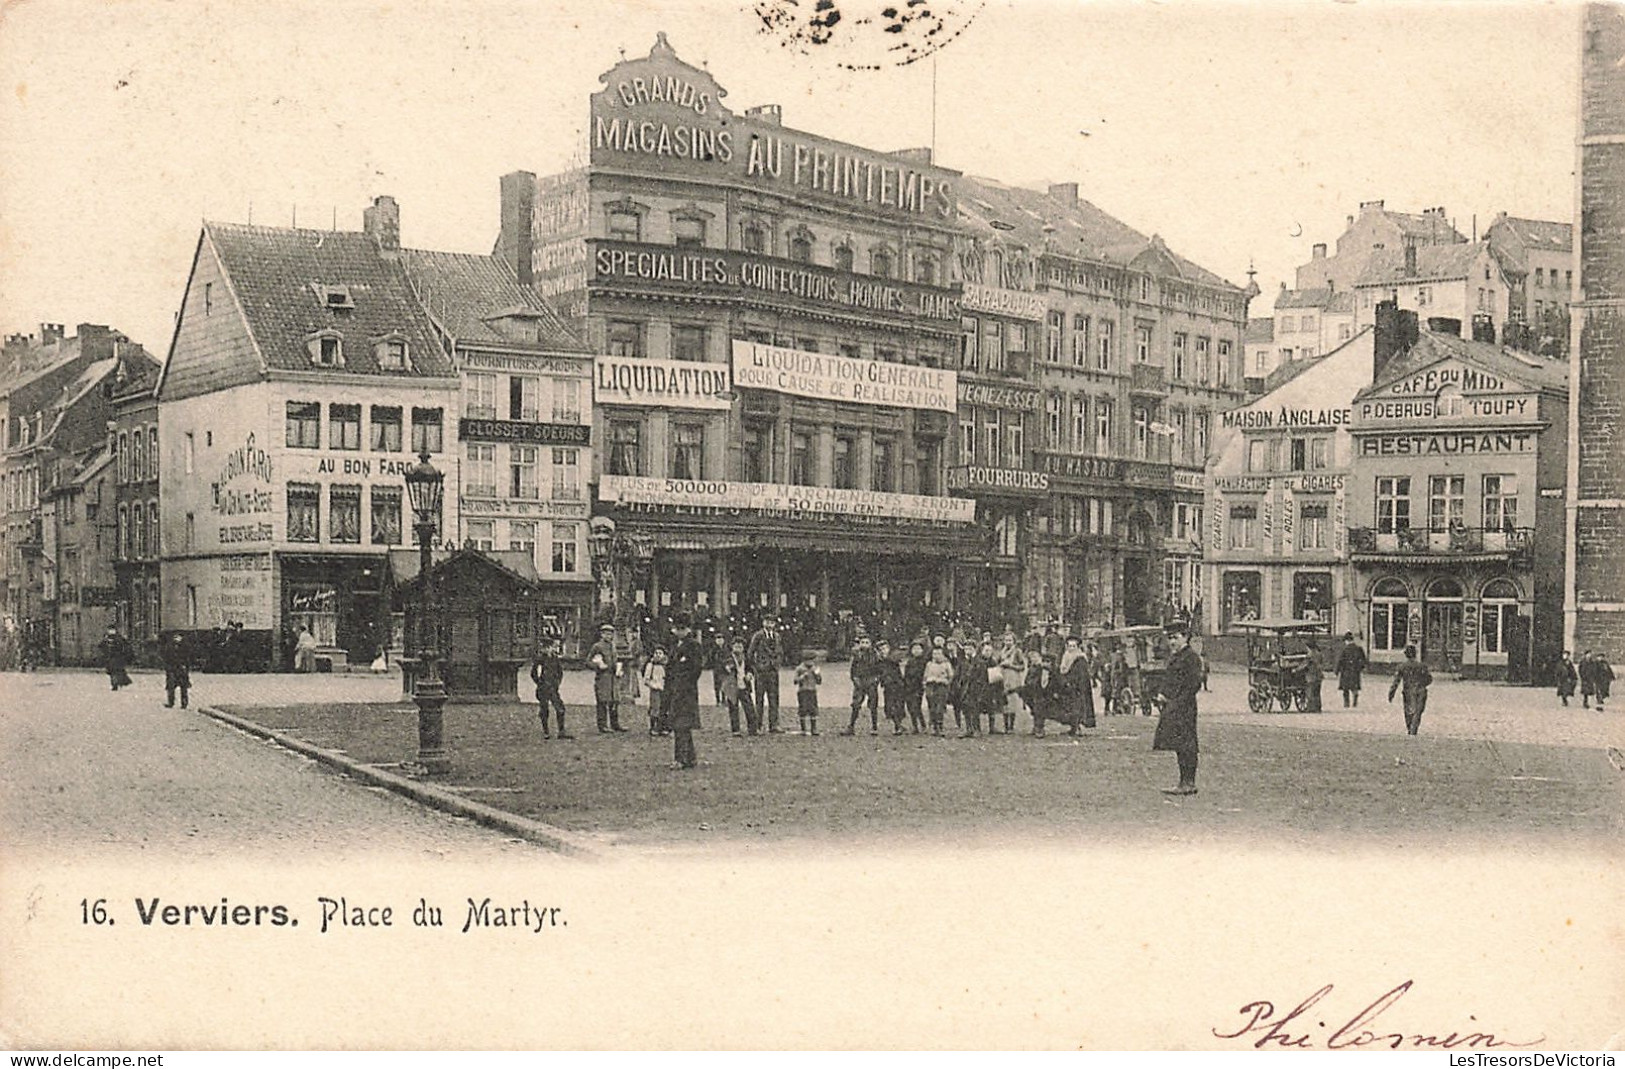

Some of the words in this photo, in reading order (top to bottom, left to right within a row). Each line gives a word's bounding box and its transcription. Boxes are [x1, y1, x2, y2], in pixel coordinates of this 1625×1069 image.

[618, 75, 711, 115] GRANDS
[596, 115, 733, 163] MAGASINS
[748, 133, 782, 178] AU
[597, 249, 728, 284] SPECIALITES
[742, 261, 838, 302] CONFECTIONS
[850, 280, 904, 311] HOMMES
[919, 293, 962, 320] DAMES
[467, 352, 538, 370] FOURNITURES
[753, 345, 863, 381] LIQUIDATION
[598, 363, 726, 400] LIQUIDATION
[739, 368, 773, 386] POUR
[778, 372, 823, 392] CAUSE
[830, 381, 846, 397] DE
[853, 383, 948, 408] REALISATION
[1440, 369, 1459, 383] DU
[1462, 369, 1504, 391] MIDI
[1222, 410, 1273, 428] MAISON
[1278, 406, 1352, 426] ANGLAISE
[1469, 399, 1528, 415] TOUPY
[467, 422, 527, 437] CLOSSET
[318, 459, 335, 473] AU
[344, 459, 370, 474] BON
[968, 466, 1049, 490] FOURRURES
[1044, 456, 1060, 473] AU
[1066, 458, 1116, 478] HASARD
[610, 476, 647, 491] PLUS
[665, 480, 728, 495] 500000
[776, 484, 901, 505] MARCHANDISES
[914, 497, 969, 511] SERONT
[1284, 480, 1295, 490] DE
[1301, 475, 1344, 490] CIGARES
[788, 498, 810, 510] 50
[814, 501, 848, 512] POUR
[854, 504, 884, 515] CENT
[81, 899, 114, 925] 16.
[135, 898, 298, 926] Verviers.
[318, 897, 392, 933] Place
[414, 898, 442, 926] du
[462, 898, 567, 933] Martyr.
